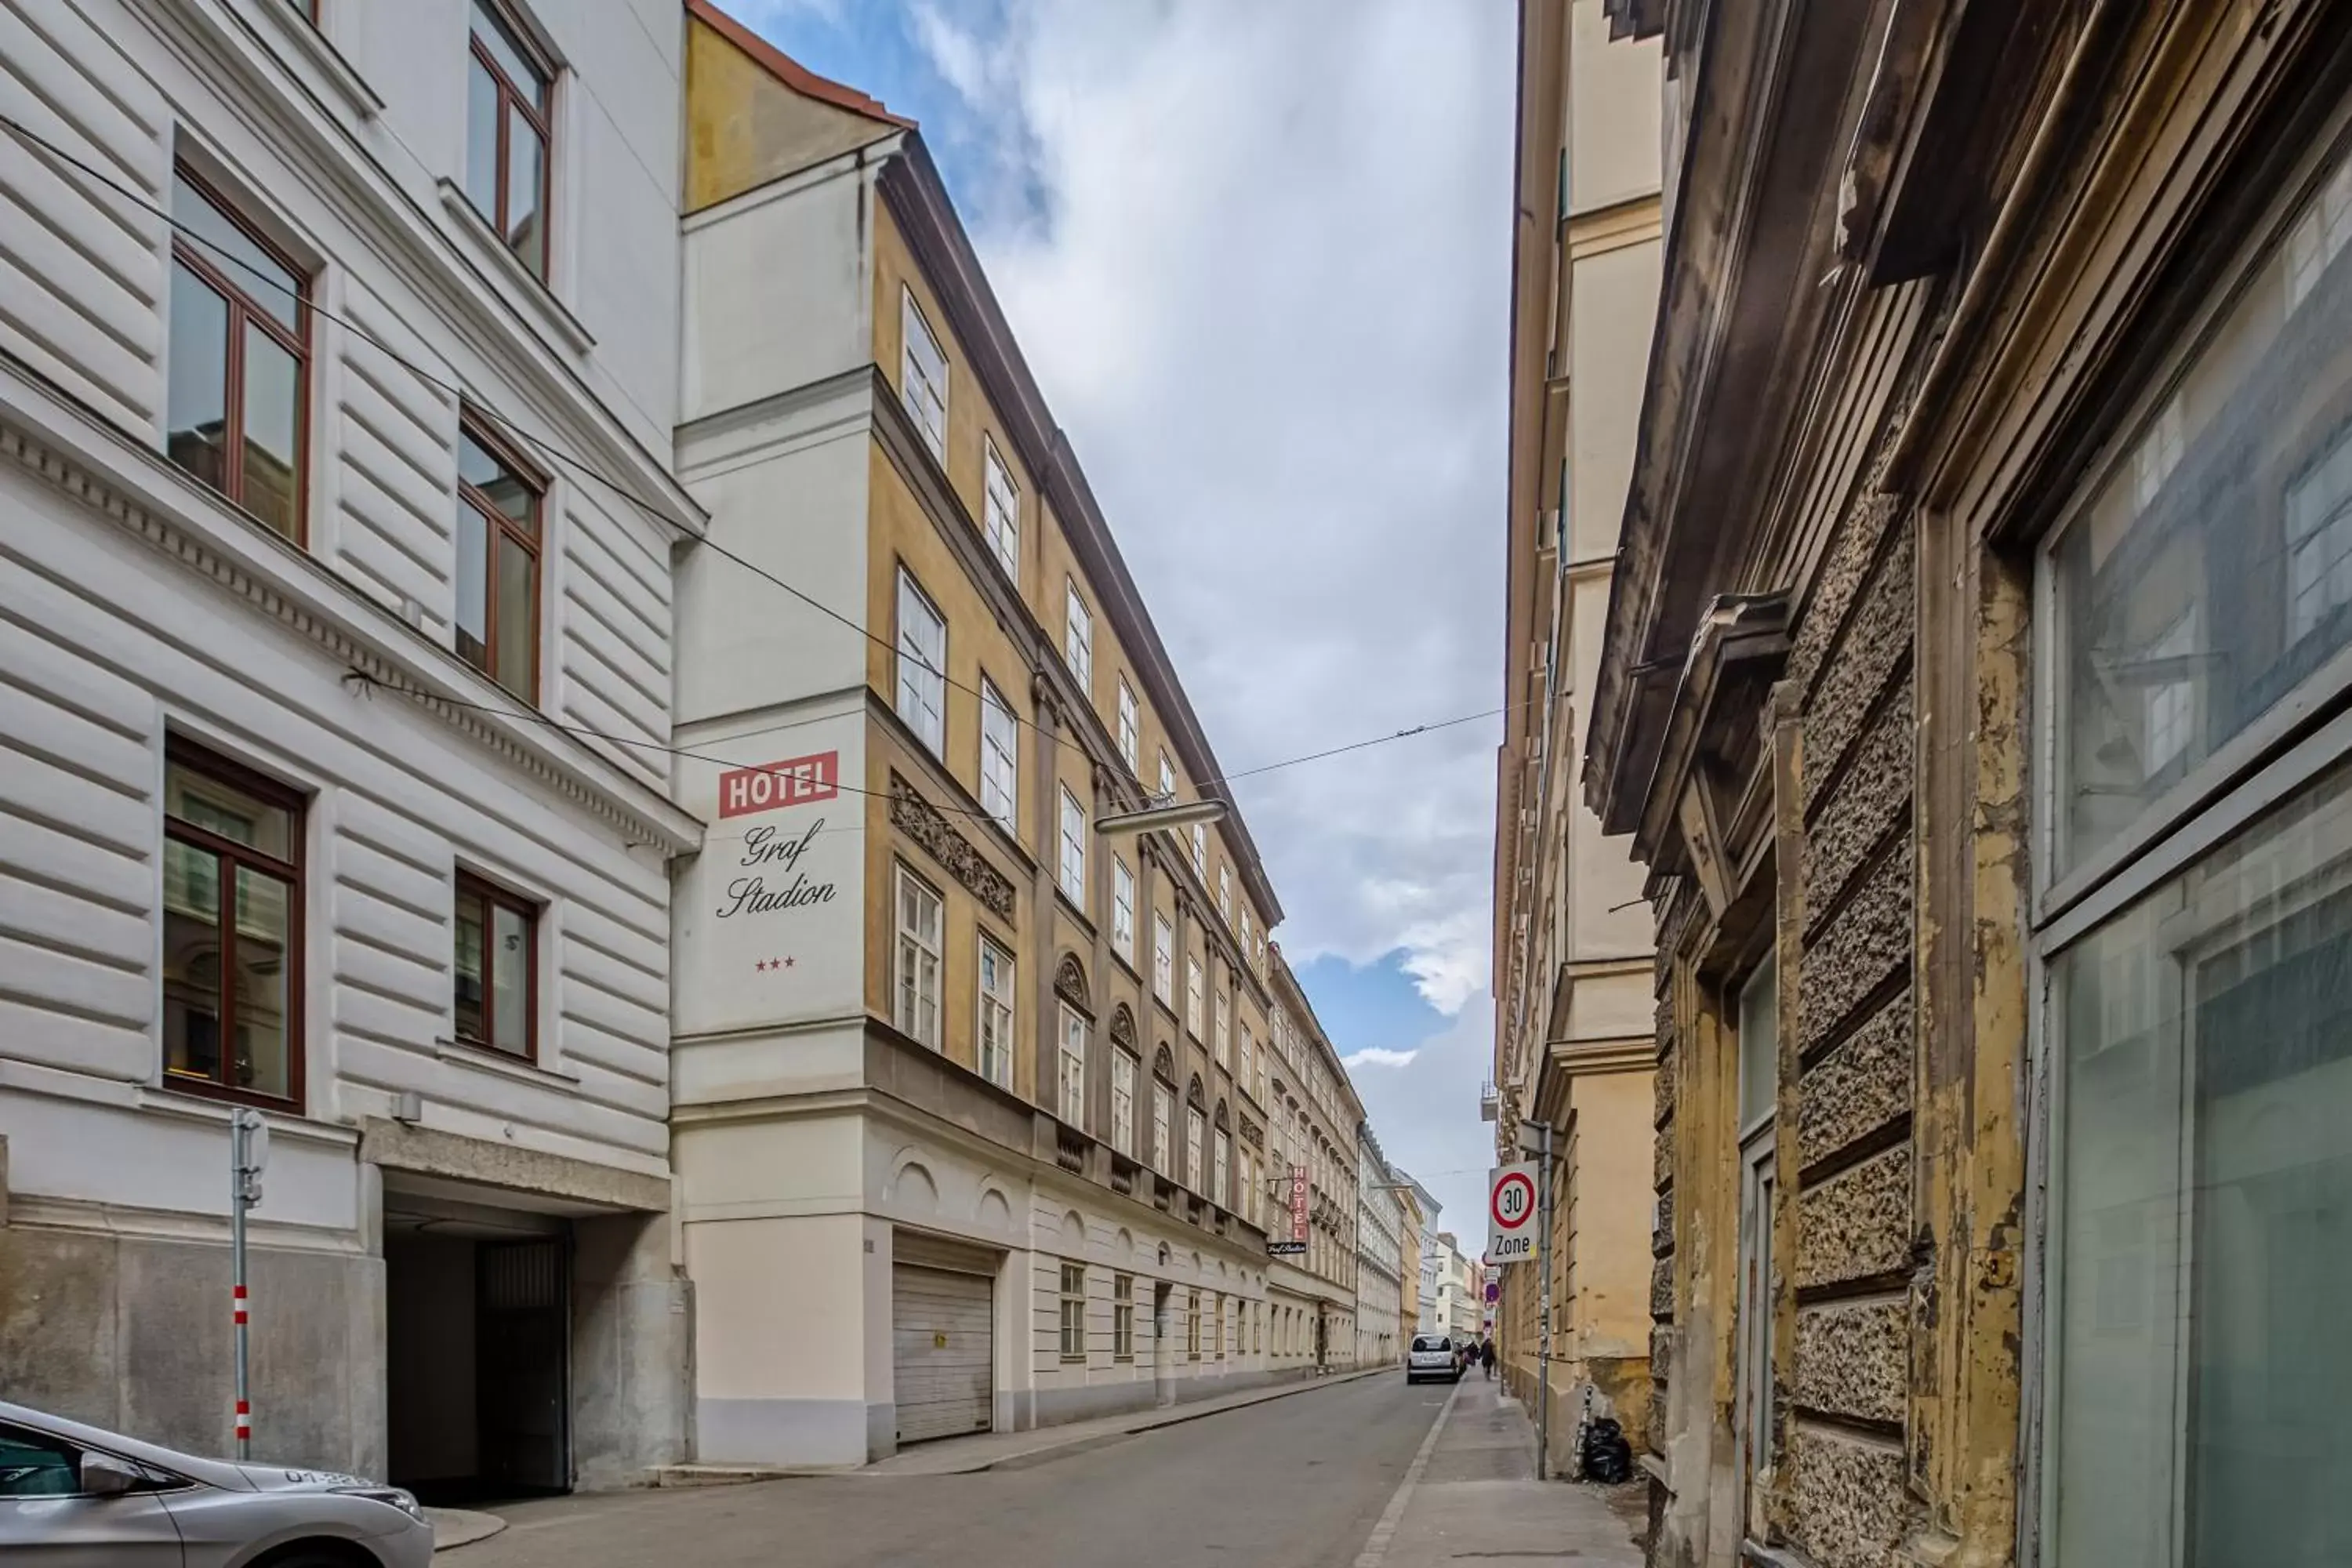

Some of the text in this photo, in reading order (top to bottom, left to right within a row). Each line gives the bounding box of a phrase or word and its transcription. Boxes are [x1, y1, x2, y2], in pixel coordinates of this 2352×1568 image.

[729, 761, 832, 810] HOTEL
[740, 818, 826, 872] Graf
[716, 873, 837, 918] Stadion
[1294, 1167, 1305, 1239] HOTEL
[1504, 1187, 1522, 1214] 30
[1495, 1235, 1530, 1255] Zone
